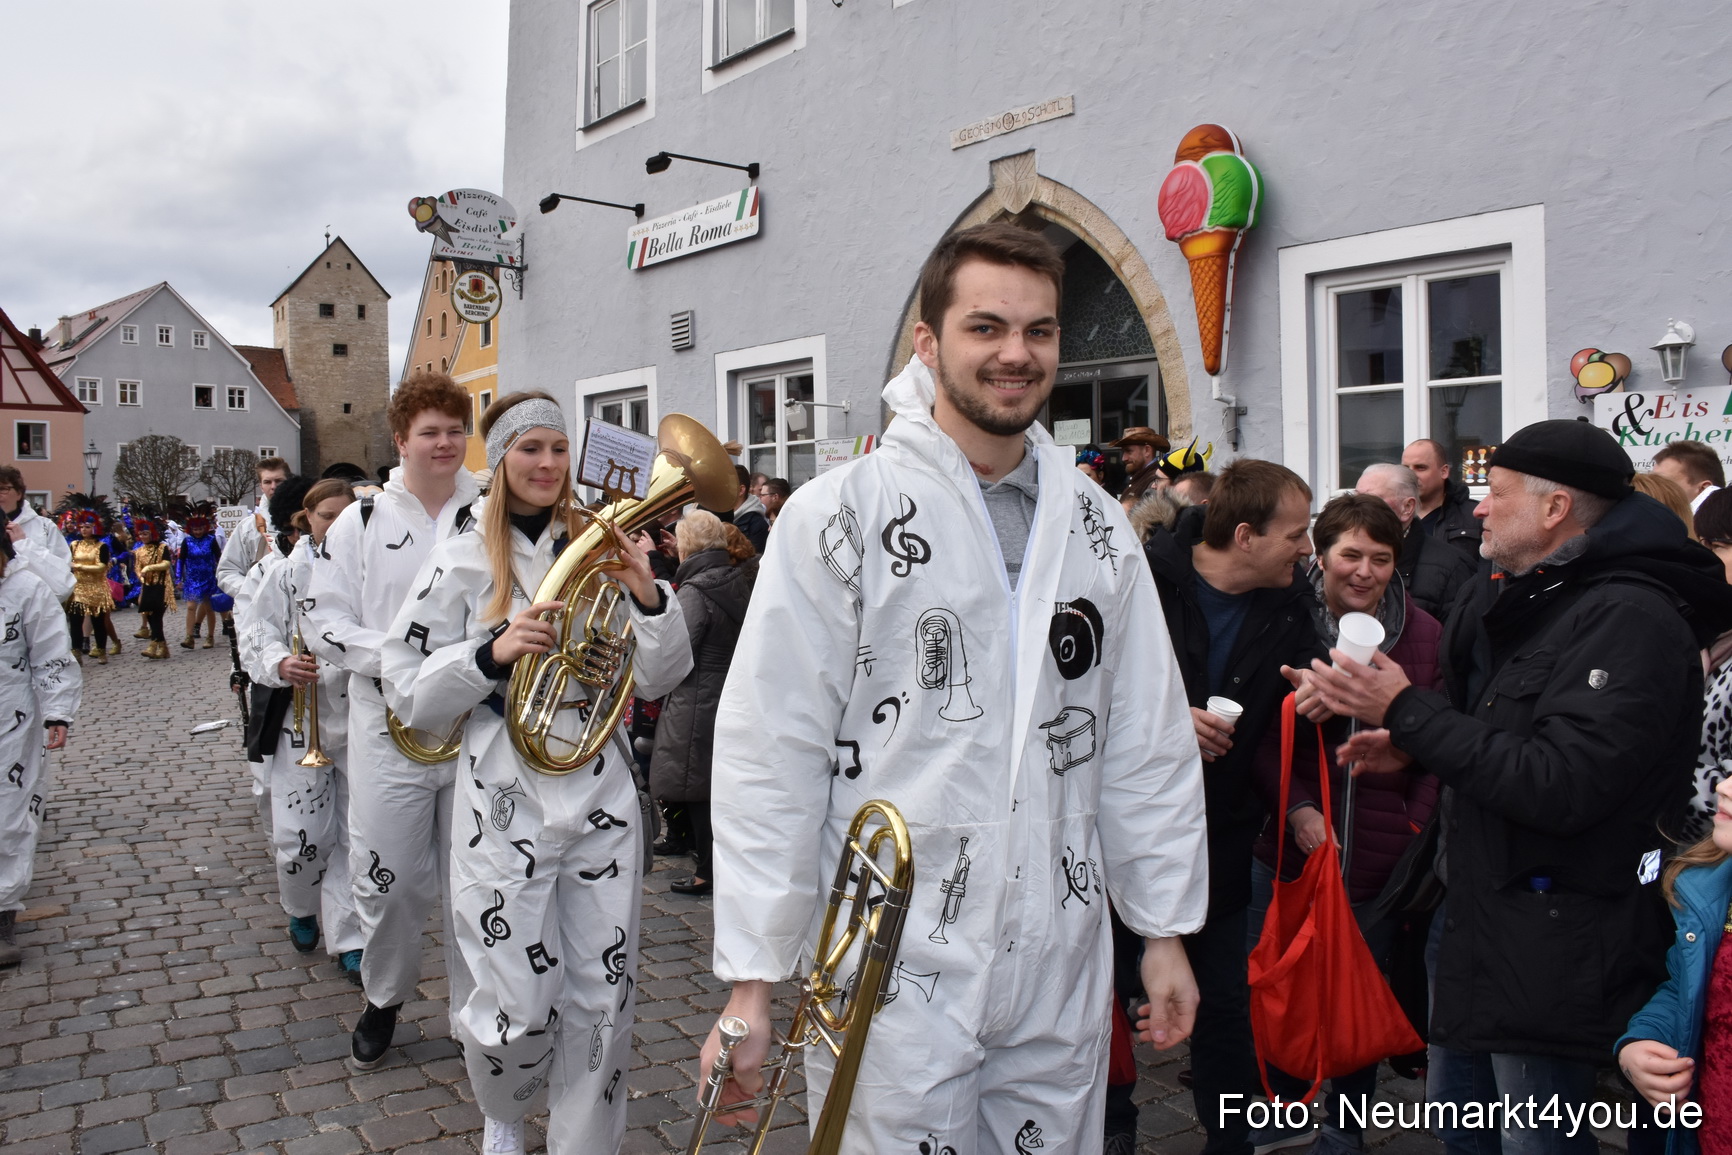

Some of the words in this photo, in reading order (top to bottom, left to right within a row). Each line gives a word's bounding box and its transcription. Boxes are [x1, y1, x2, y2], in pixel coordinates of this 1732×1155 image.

[455, 190, 498, 206] Pizzeria
[465, 206, 488, 219] Café
[652, 217, 678, 232] Pizzeria
[683, 210, 699, 223] Café
[704, 199, 732, 216] Eisdiele
[454, 218, 498, 234] Eisdiele
[647, 231, 684, 259] Bella
[688, 221, 733, 247] Roma
[440, 246, 474, 257] Roma
[461, 242, 491, 252] Bella
[1612, 393, 1654, 436] &
[1650, 394, 1709, 420] Eis
[818, 447, 839, 456] Bella
[825, 454, 848, 462] Roma
[221, 510, 243, 518] GOLD
